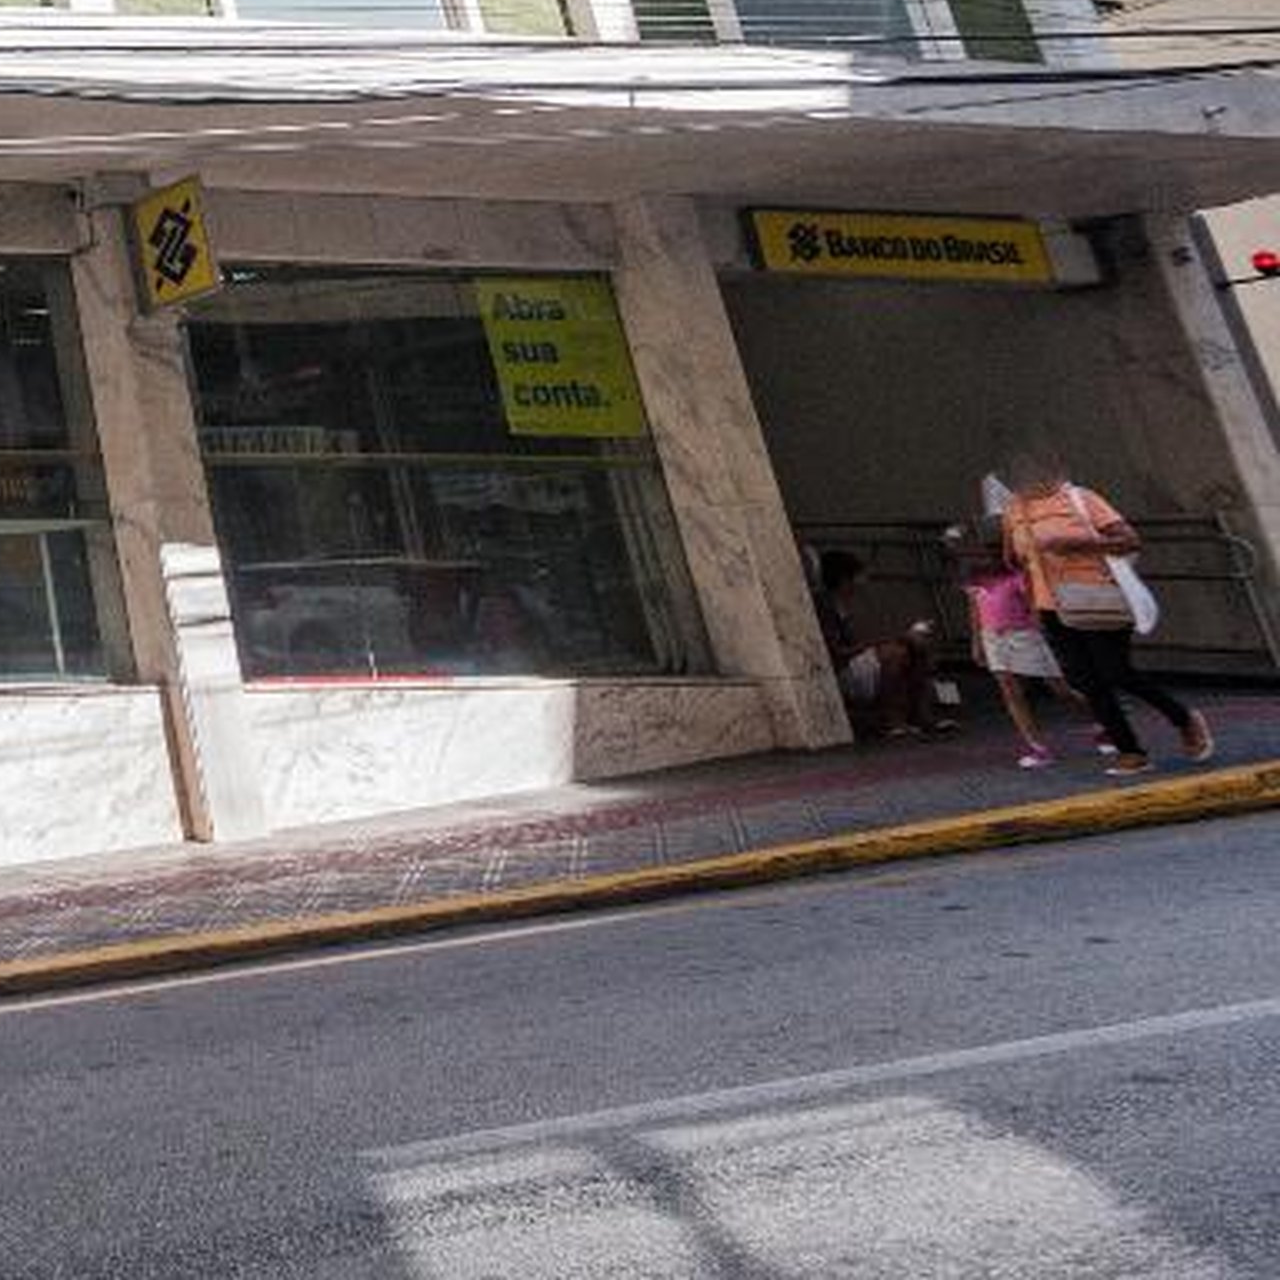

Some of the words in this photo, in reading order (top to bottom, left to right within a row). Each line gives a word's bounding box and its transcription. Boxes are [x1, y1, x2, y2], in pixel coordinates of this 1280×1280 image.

[824, 230, 907, 261] BANCO
[942, 233, 1025, 266] BRASIL
[494, 292, 565, 321] Abra
[502, 341, 559, 364] sua
[514, 378, 612, 408] conta.
